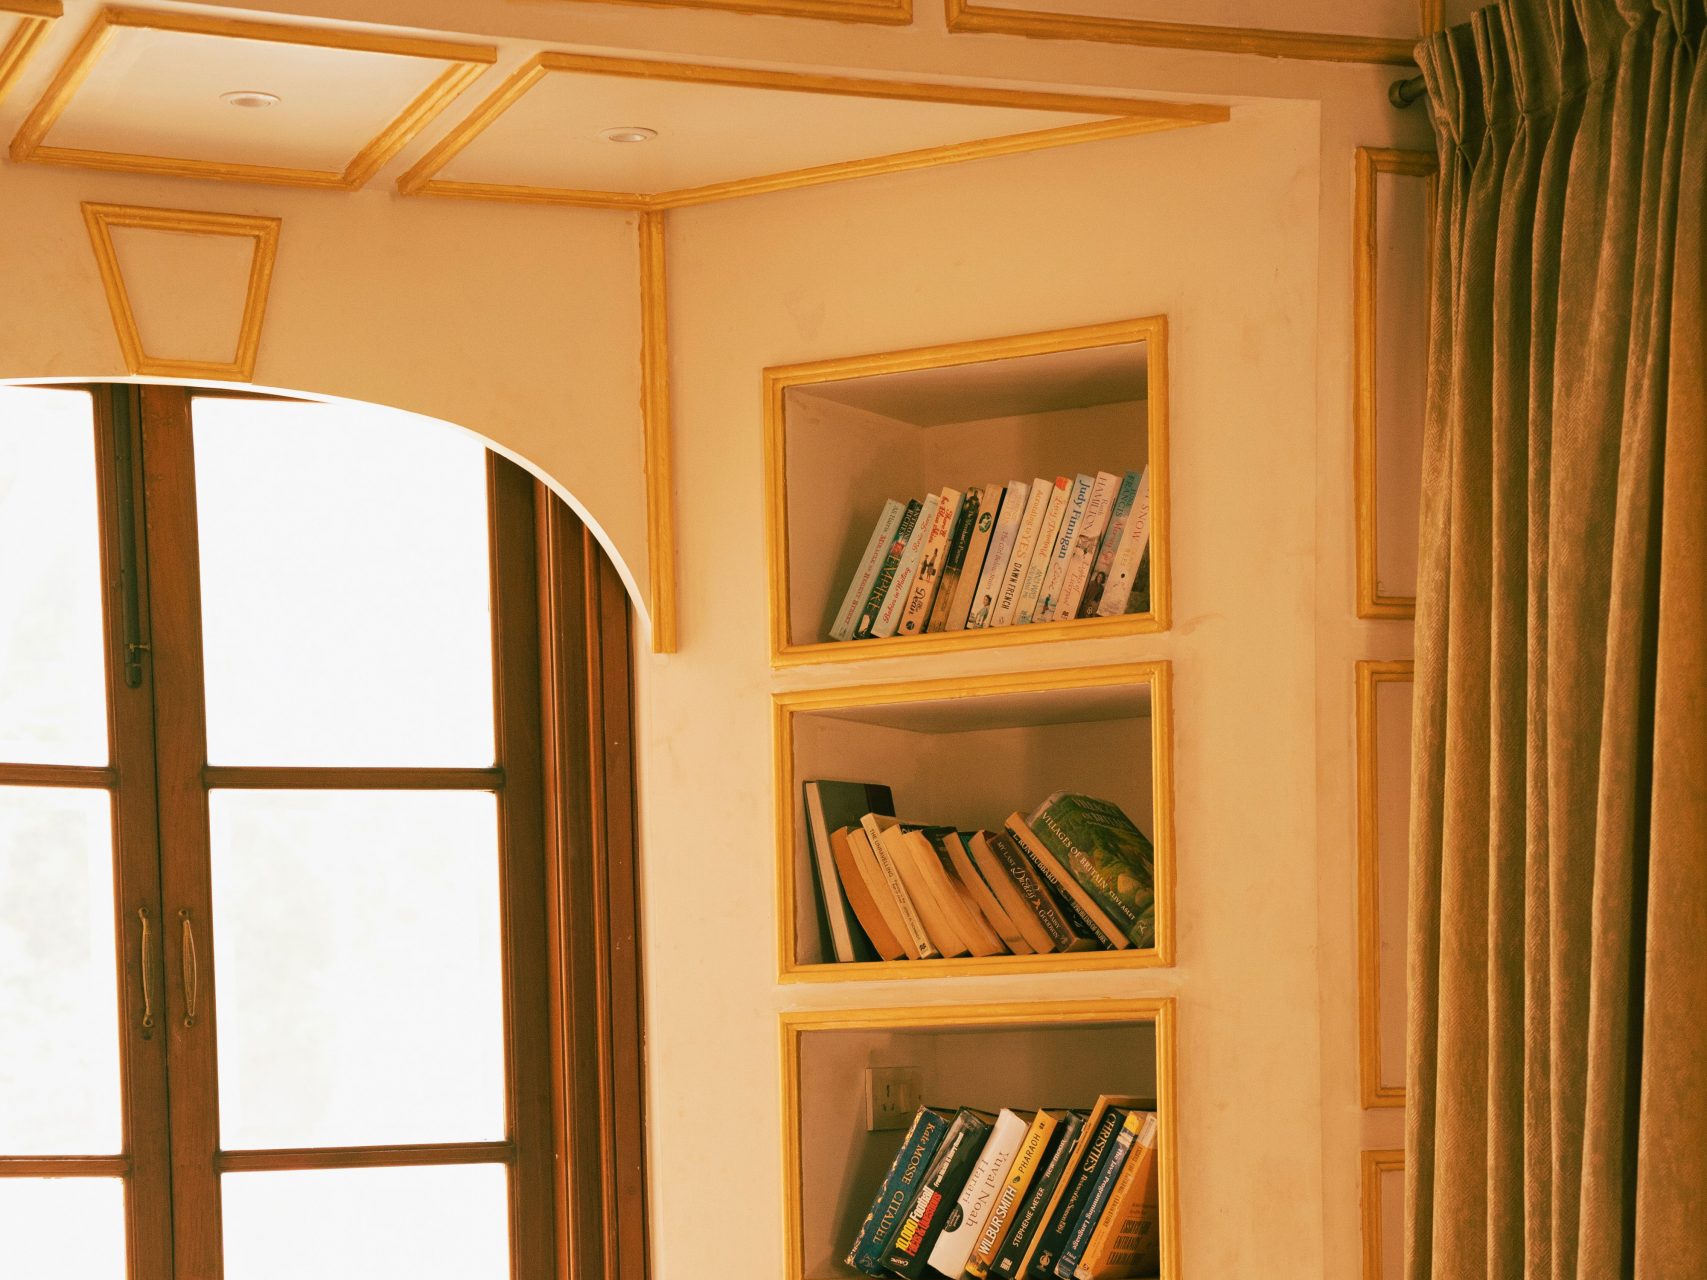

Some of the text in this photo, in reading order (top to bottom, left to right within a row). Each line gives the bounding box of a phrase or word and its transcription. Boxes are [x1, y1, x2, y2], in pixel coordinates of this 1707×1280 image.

[897, 508, 913, 536] RICHES
[1055, 479, 1091, 560] Judy Finnigan
[1130, 503, 1149, 541] SNOW
[1015, 533, 1032, 560] YES
[865, 553, 900, 612] EMPIRE
[907, 586, 926, 616] Dean
[1001, 562, 1022, 610] DAWN FRENCH
[868, 828, 894, 877] THE UNRAVELLING
[996, 841, 1006, 851] MY
[1003, 851, 1016, 866] LAST
[1017, 838, 1032, 854] RON
[1029, 852, 1058, 885] HUBBARD
[1042, 812, 1136, 921] VILLAGES OF BRITAIN CLIVE ASLET
[1037, 909, 1060, 938] GOODWIN
[1044, 909, 1062, 930] DAISY
[900, 1122, 935, 1185] Kate MOSSE
[1016, 1132, 1041, 1173] PHARAOH
[1105, 1159, 1118, 1175] Java
[1112, 1147, 1124, 1161] The
[961, 1158, 989, 1204] Harari
[964, 1149, 1010, 1229] Yuval Noah
[1084, 1175, 1111, 1220] Programming
[871, 1188, 906, 1246] CITADEL
[893, 1217, 919, 1252] 10,000
[908, 1184, 934, 1222] Football
[976, 1185, 1018, 1255] WILBUR SMITH
[1011, 1186, 1045, 1247] STEPHENIE MEYER
[1070, 1218, 1091, 1250] Language
[905, 1232, 923, 1256] Facts
